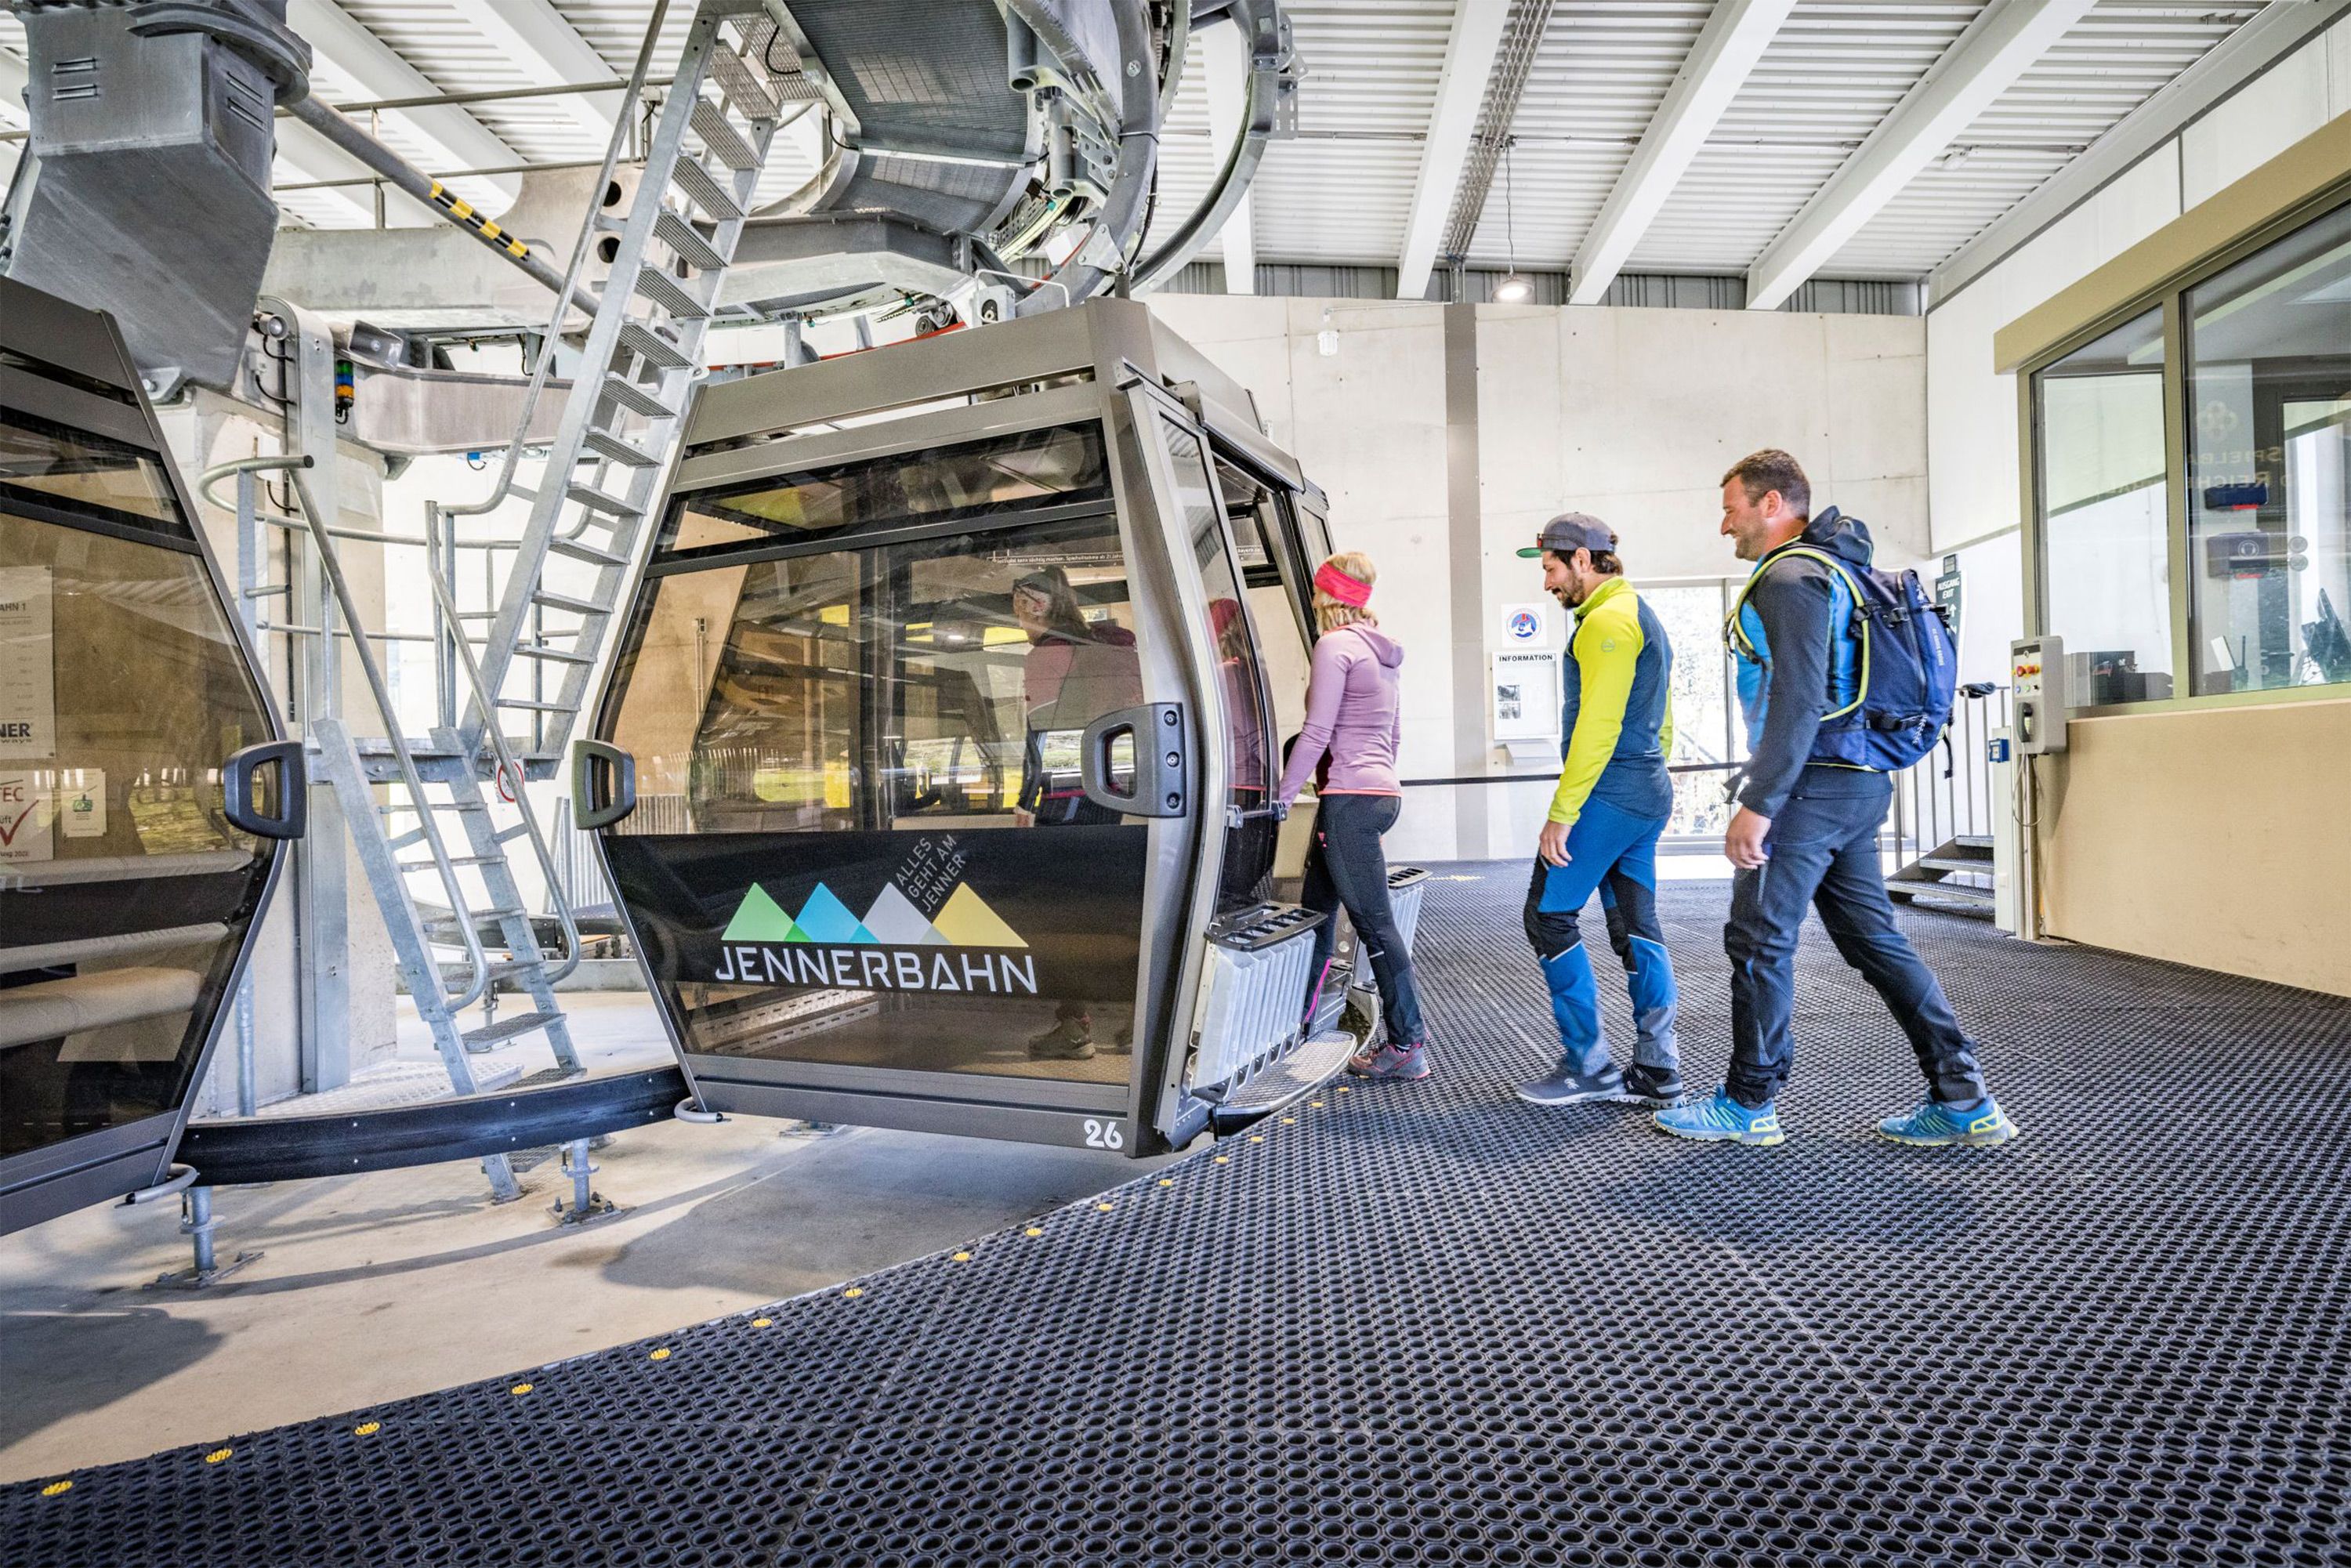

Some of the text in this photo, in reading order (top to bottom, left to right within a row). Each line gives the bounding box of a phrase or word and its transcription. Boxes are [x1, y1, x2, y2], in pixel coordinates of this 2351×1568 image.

[1937, 578, 1960, 592] AUSGANG
[1942, 588, 1954, 599] EXIT
[0, 787, 24, 802] EC
[896, 838, 932, 887] ALLES
[907, 834, 957, 899] GEHT AM
[922, 854, 966, 912] JENNER
[715, 946, 1038, 994] JENNERBAHN
[1084, 1119, 1123, 1150] 26
